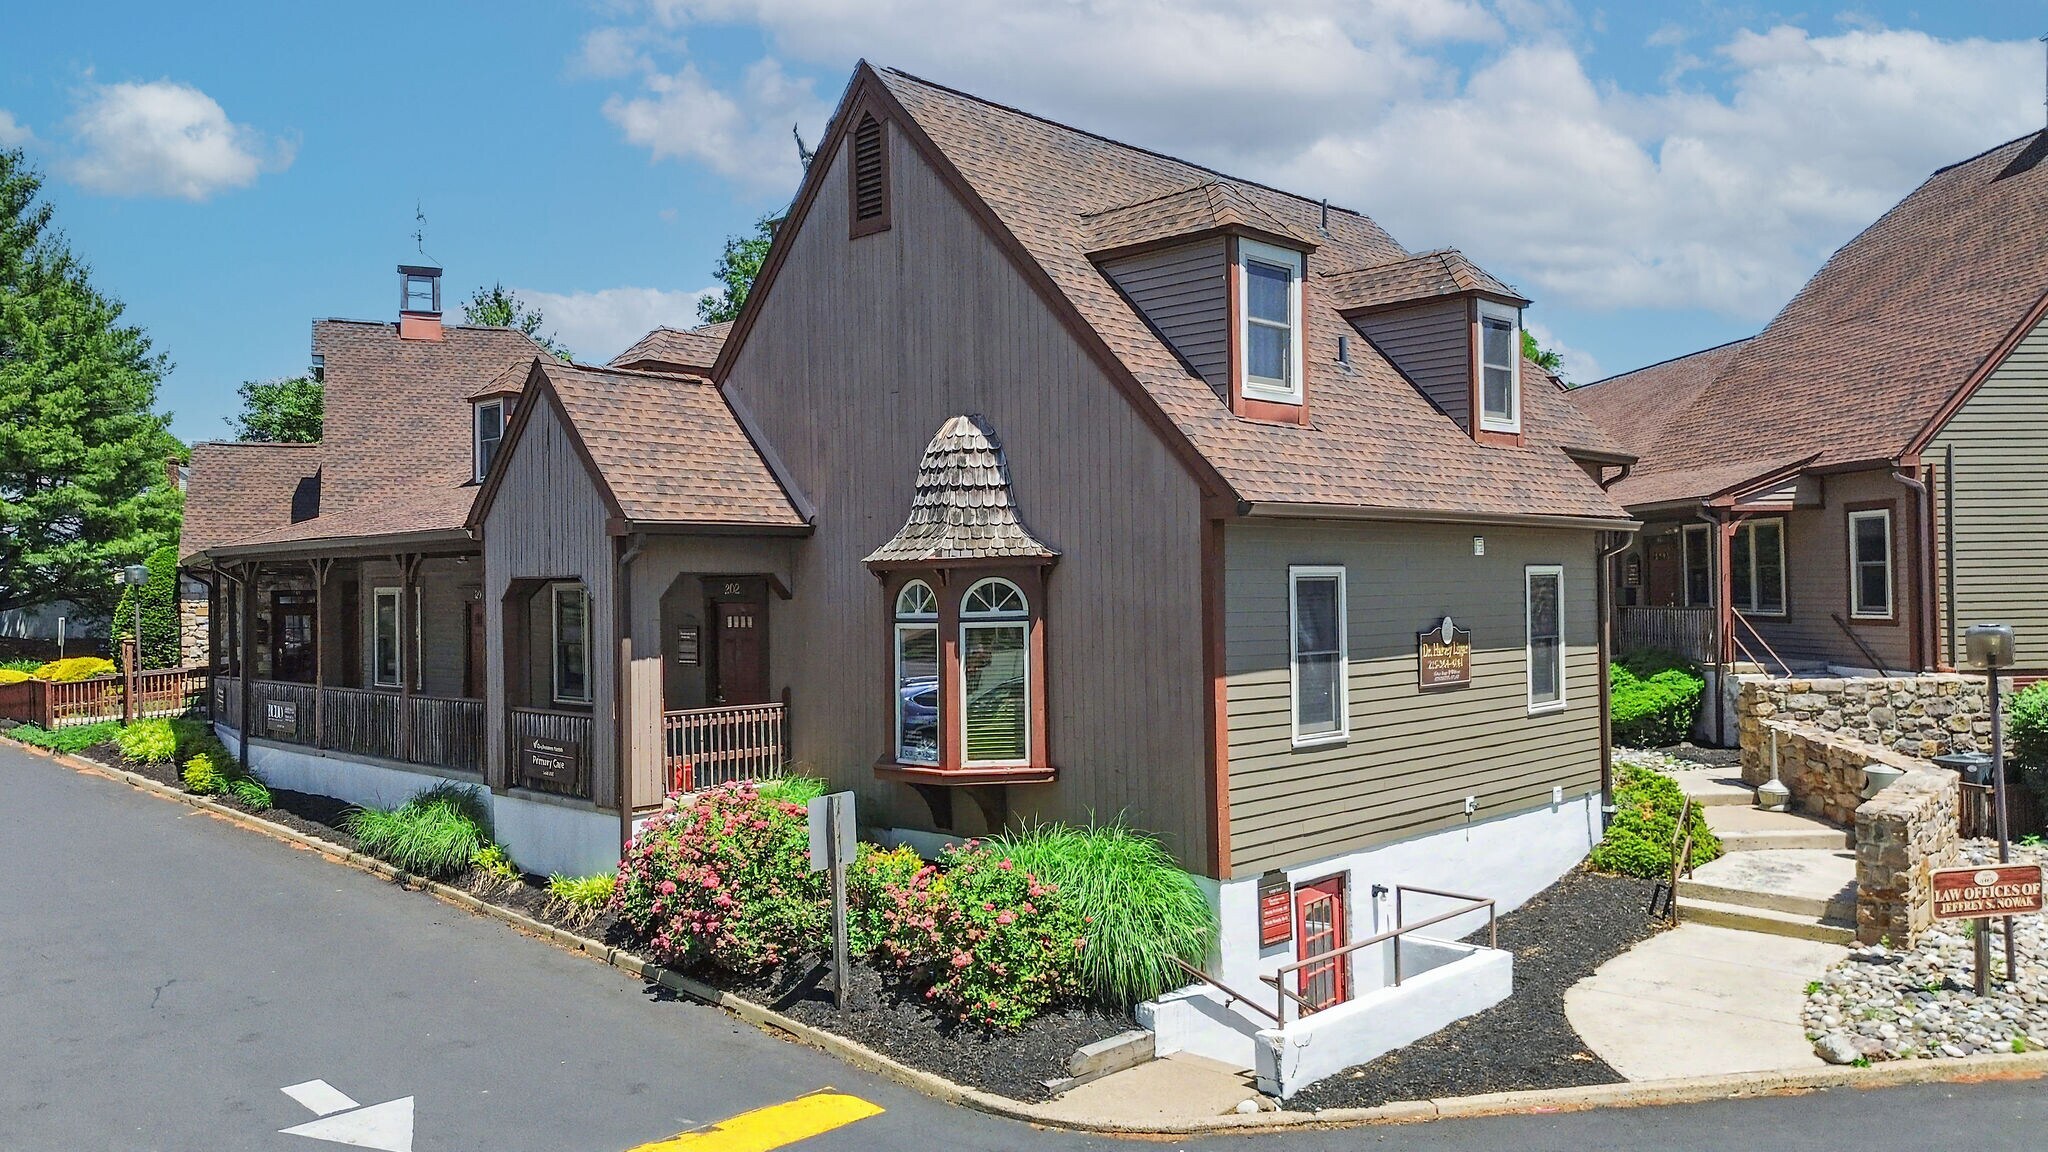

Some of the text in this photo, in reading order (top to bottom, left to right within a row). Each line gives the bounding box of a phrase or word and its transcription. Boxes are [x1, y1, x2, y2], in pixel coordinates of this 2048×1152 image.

[724, 583, 740, 595] 202
[532, 755, 565, 770] Primary Care
[1934, 882, 2041, 903] LAW OFFICES OF
[1940, 897, 2036, 914] JEFFREY S. NOWAK
